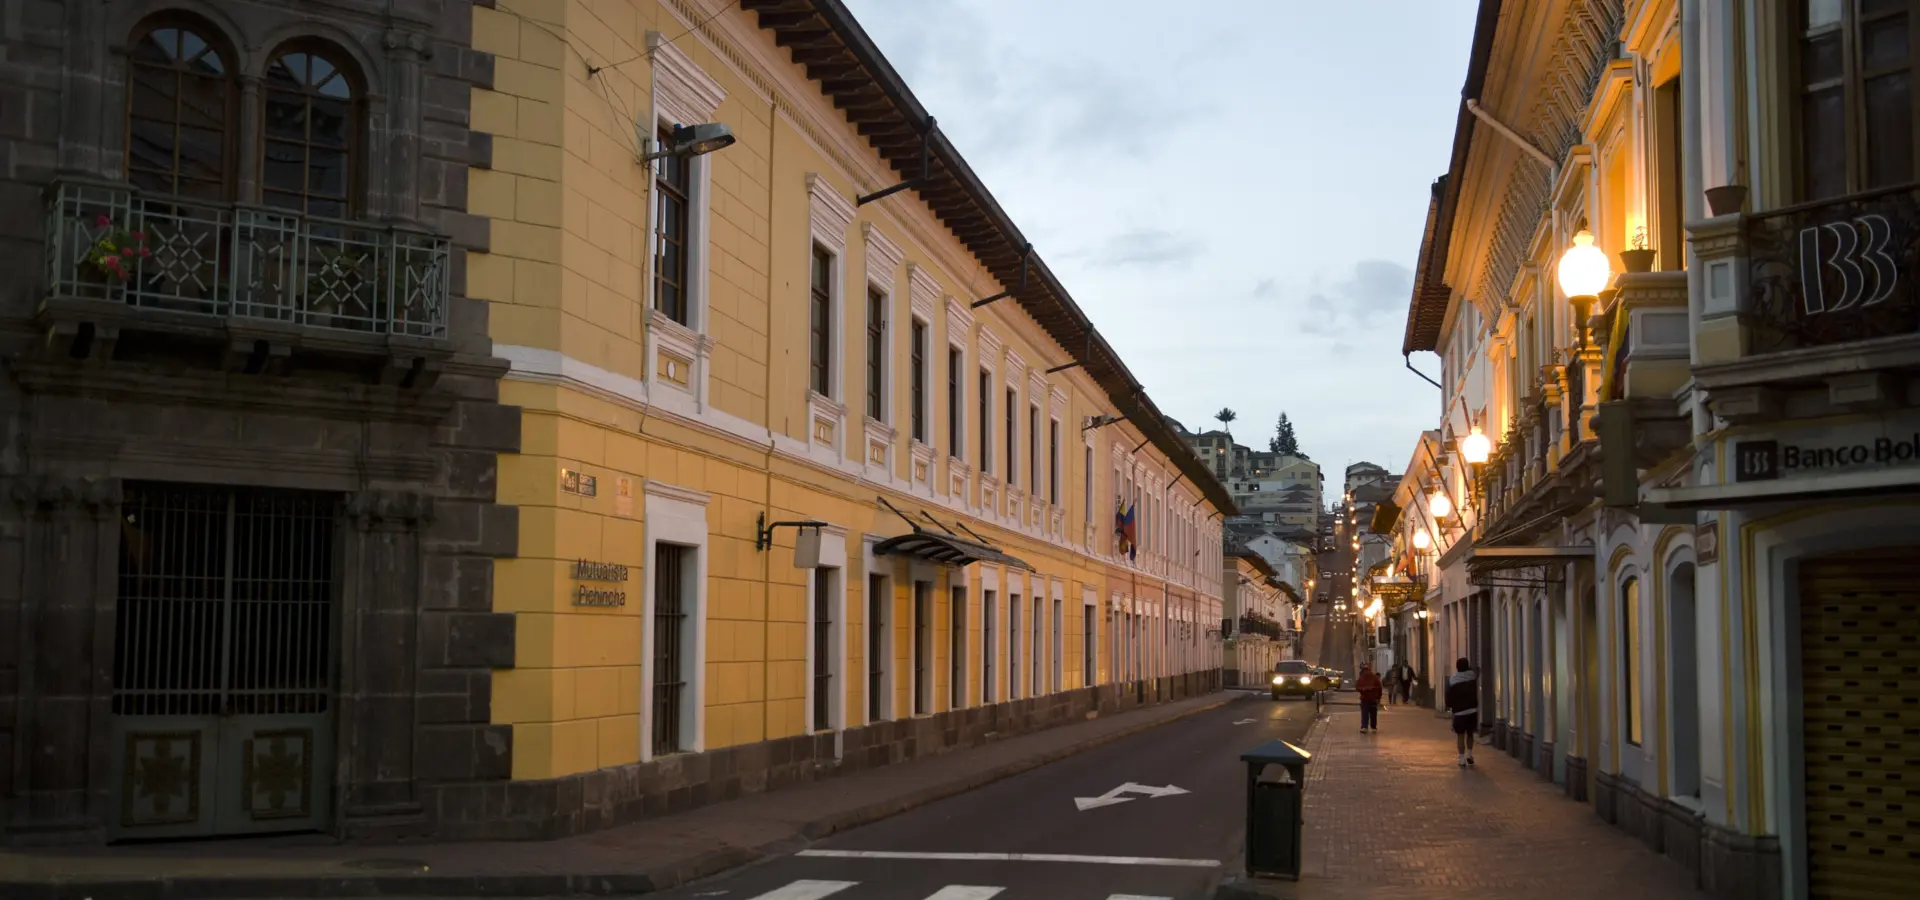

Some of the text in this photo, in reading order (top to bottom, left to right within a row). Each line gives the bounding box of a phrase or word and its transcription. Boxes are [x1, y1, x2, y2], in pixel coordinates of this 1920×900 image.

[1784, 446, 1868, 468] Banco
[1875, 432, 1920, 462] Bol
[578, 558, 628, 581] Mutualista
[579, 584, 625, 606] Pichincha
